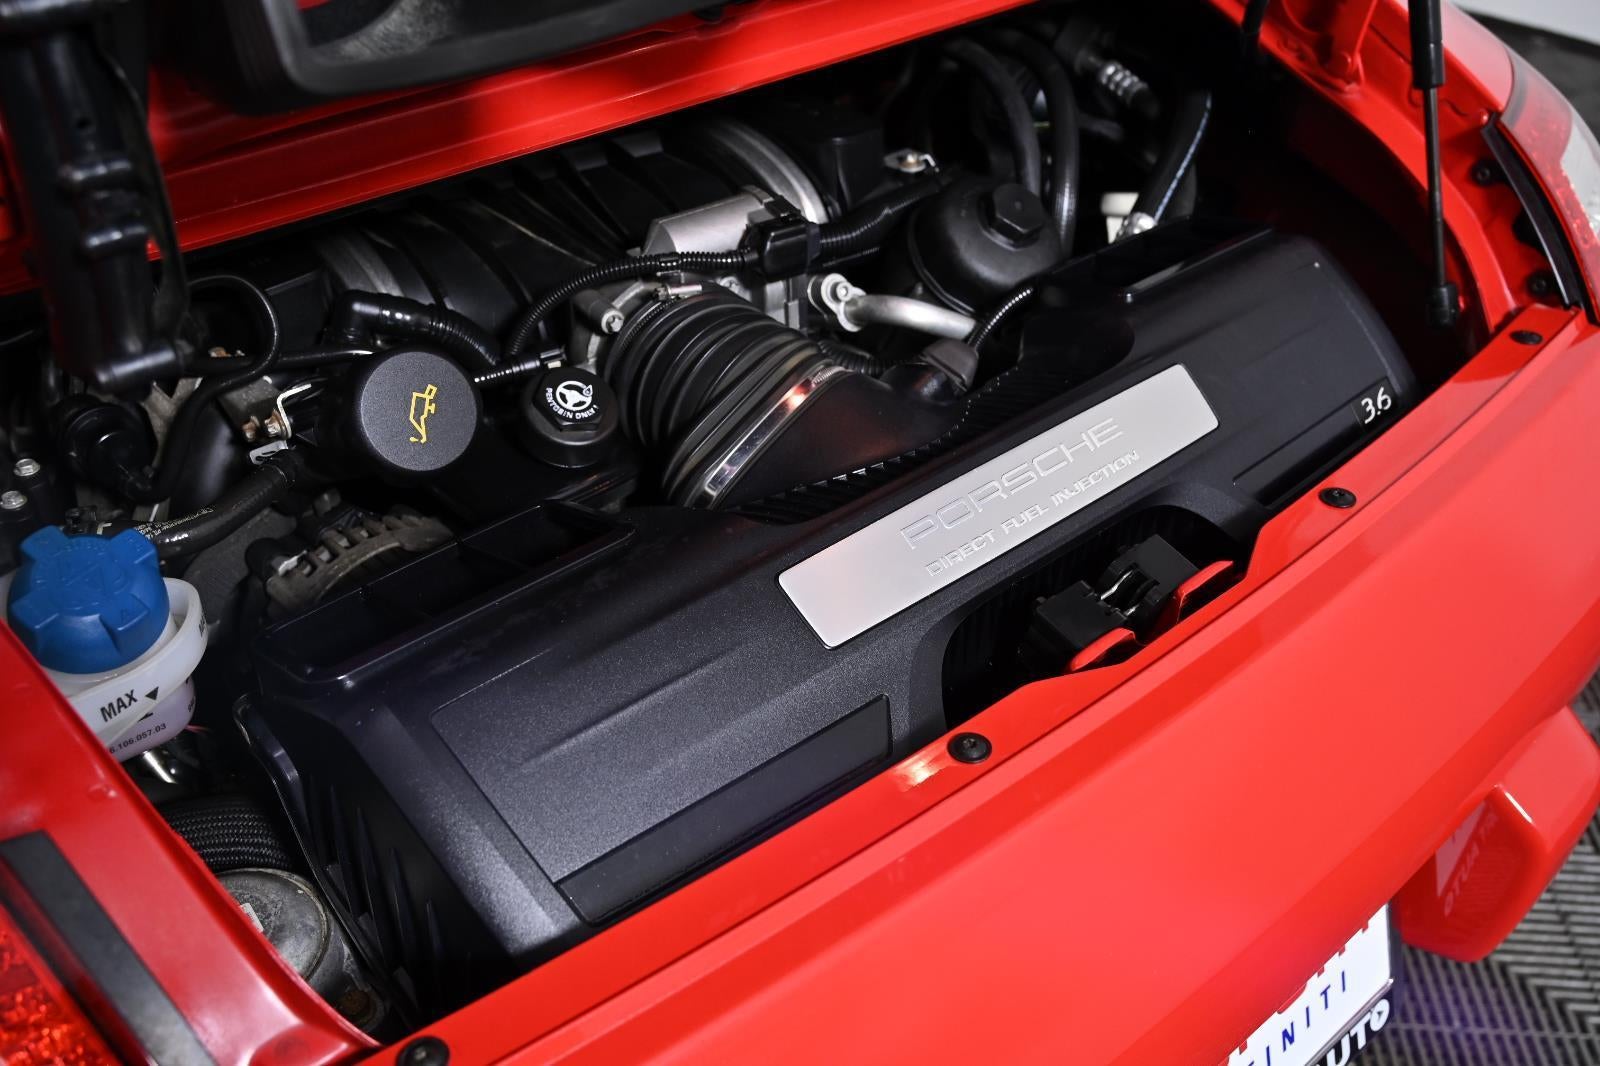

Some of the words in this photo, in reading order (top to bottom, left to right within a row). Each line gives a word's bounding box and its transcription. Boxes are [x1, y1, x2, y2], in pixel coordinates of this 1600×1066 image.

[546, 387, 573, 419] PENTOBIN
[1361, 386, 1392, 424] 3.6
[900, 417, 1124, 550] PORSCHE
[924, 528, 997, 577] DIRECT
[1000, 503, 1049, 535] FUEL
[1050, 449, 1140, 507] INJECTION
[100, 689, 138, 722] MAX
[1248, 970, 1346, 1066] INITI
[1316, 998, 1390, 1066] UTO
